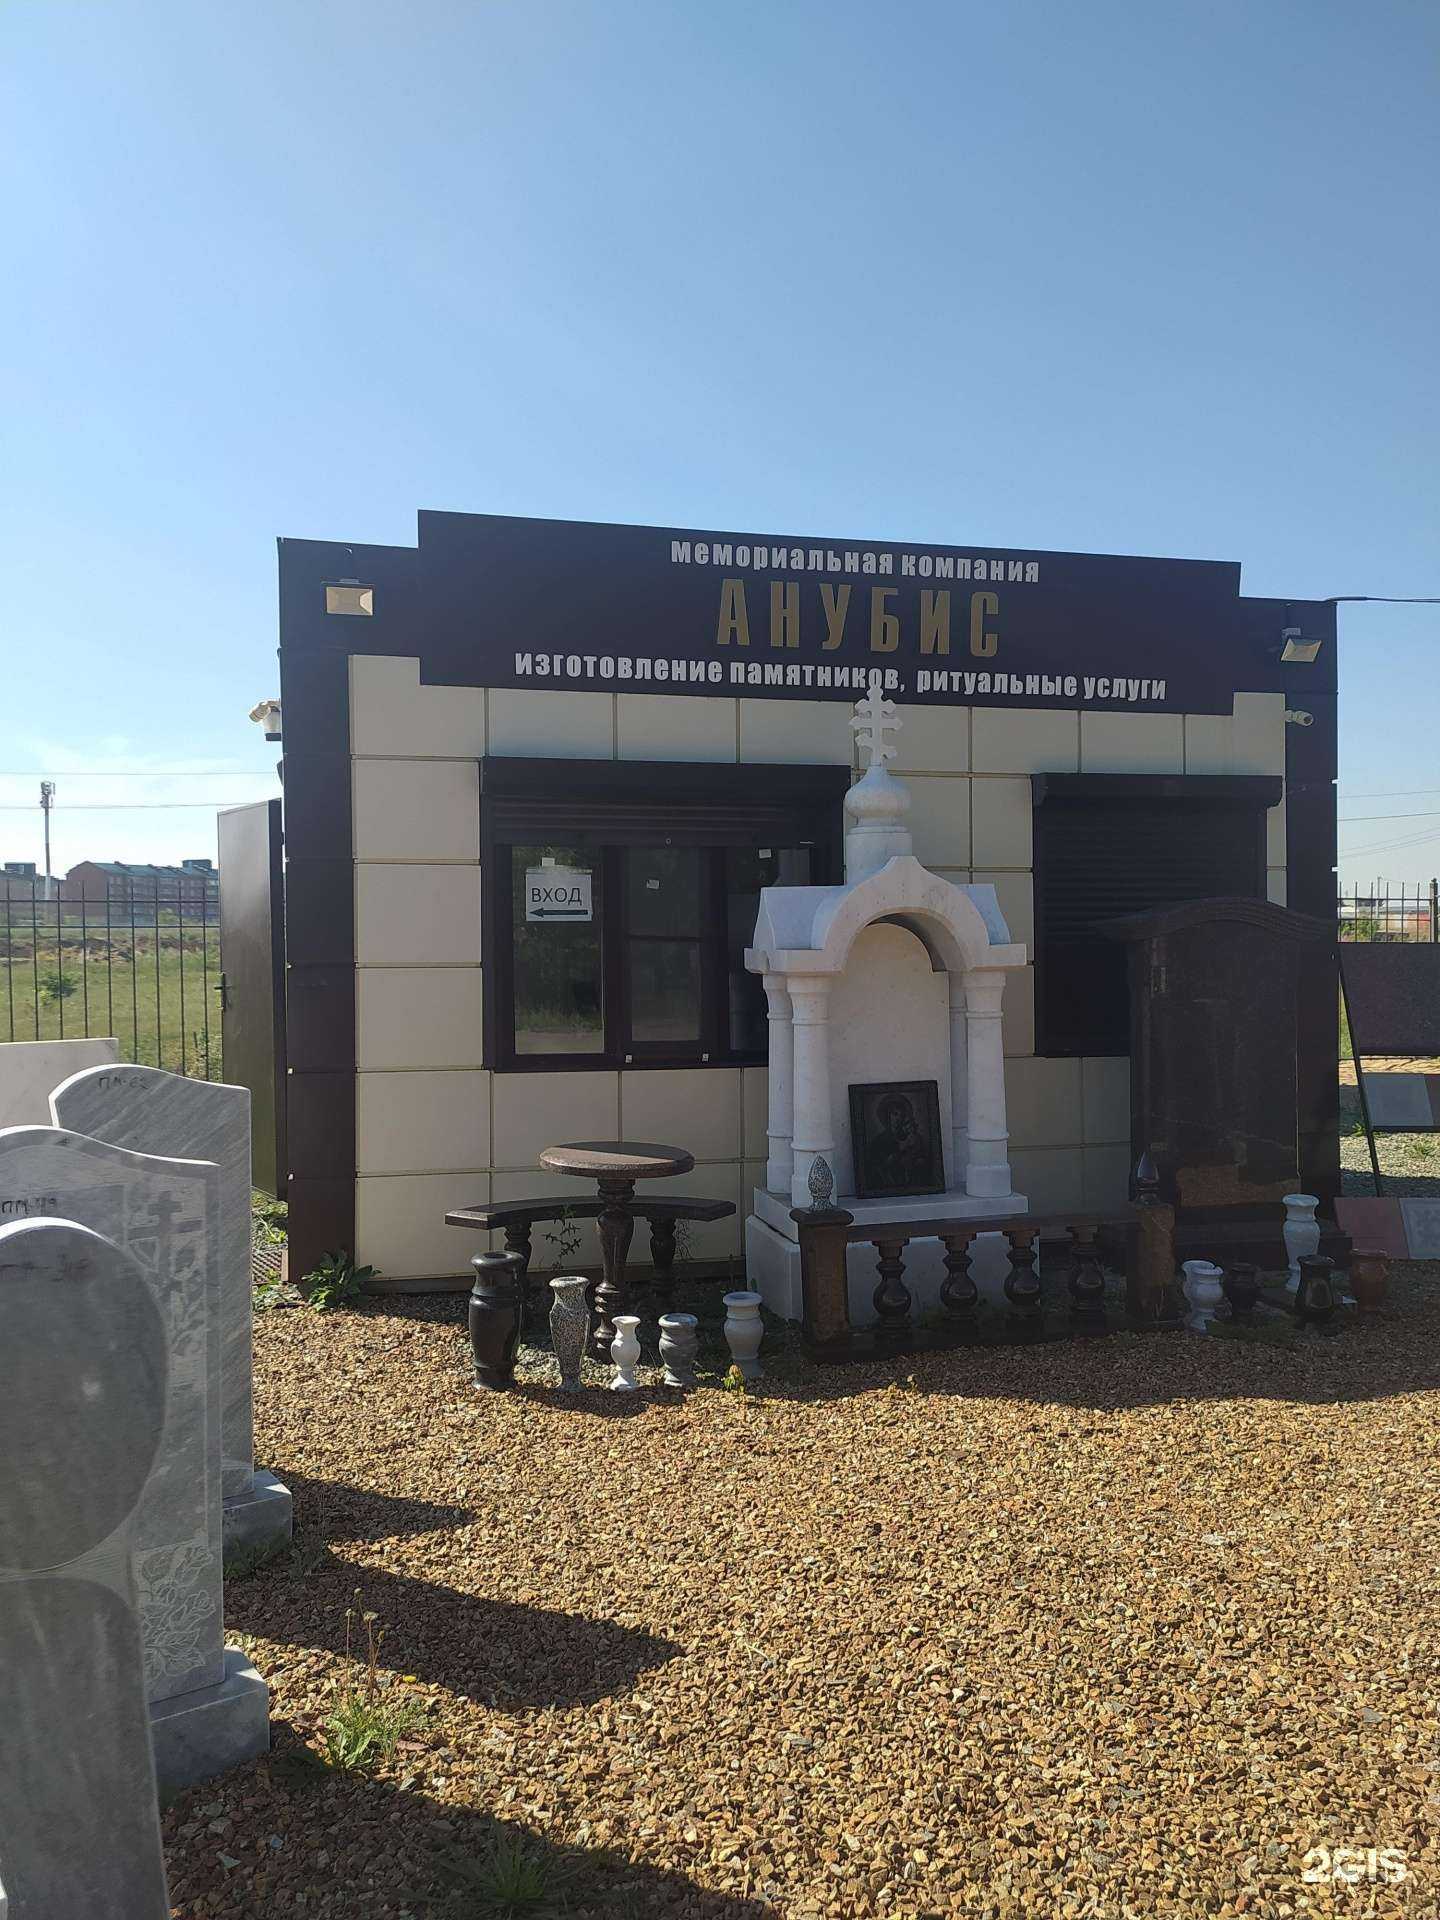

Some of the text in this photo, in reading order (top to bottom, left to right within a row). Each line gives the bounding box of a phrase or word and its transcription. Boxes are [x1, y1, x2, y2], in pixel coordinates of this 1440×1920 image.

[671, 540, 1040, 583] мемориальная компания
[717, 578, 1000, 658] АНУБИС
[514, 652, 1167, 702] изготовление памятников, ритуальные услуги
[531, 887, 582, 906] ВХОД
